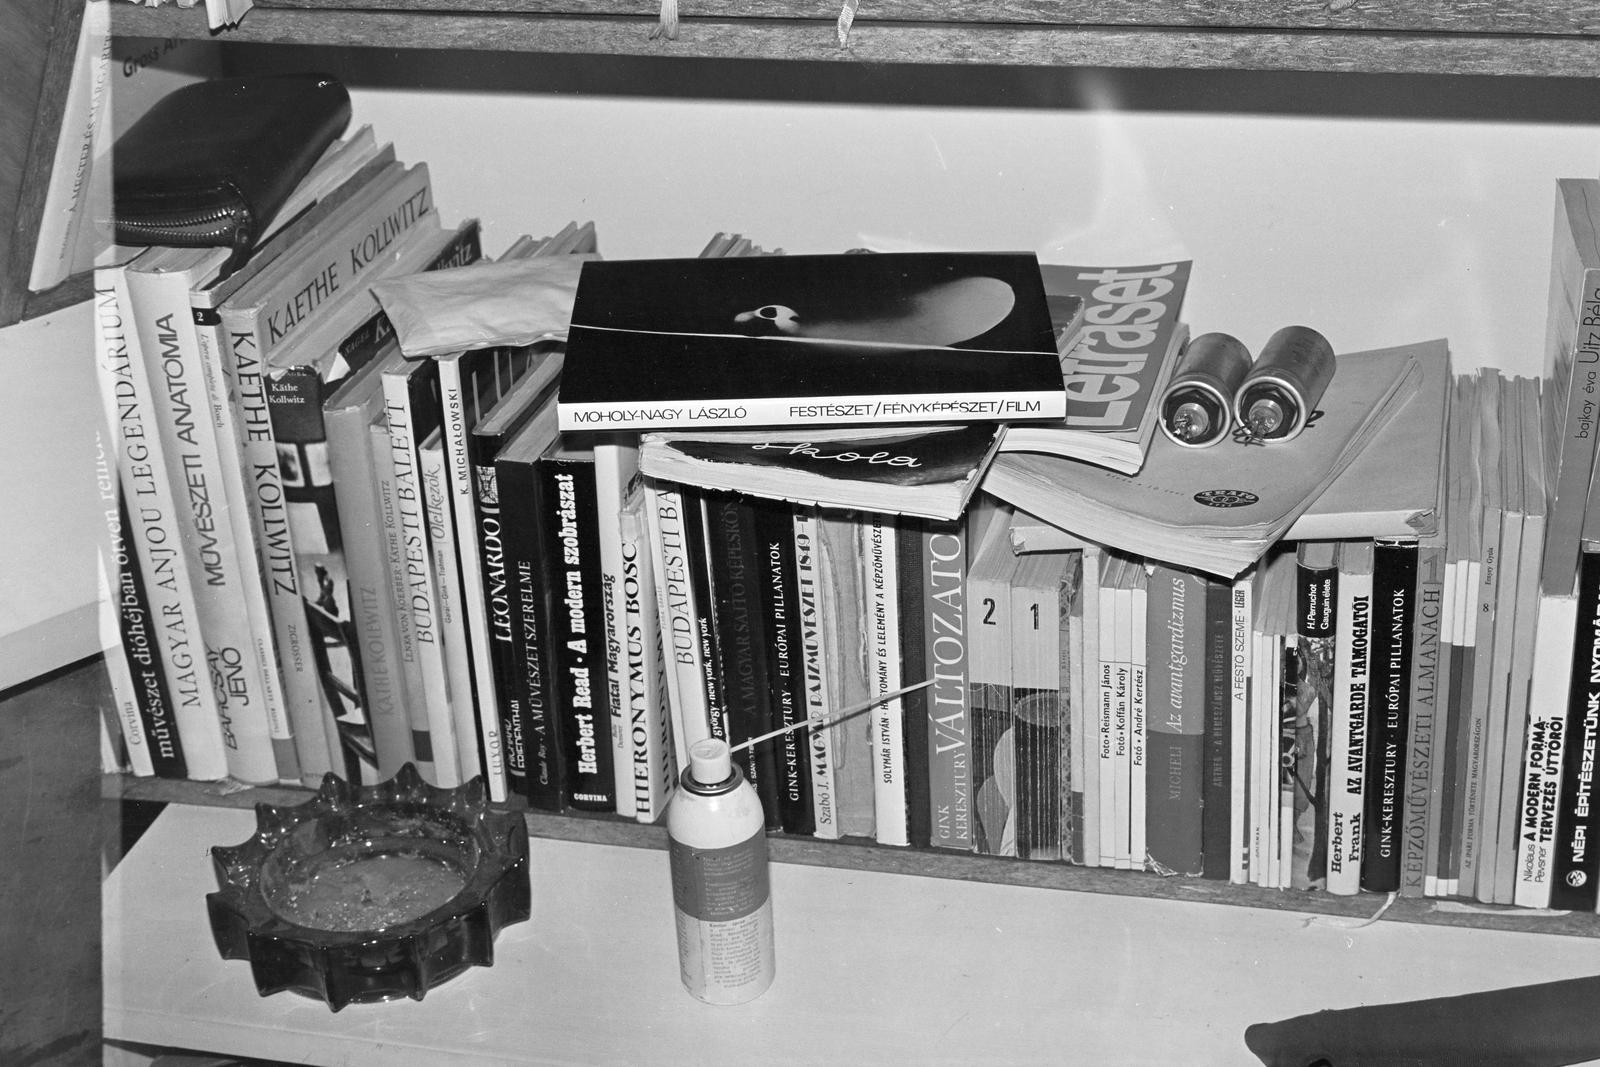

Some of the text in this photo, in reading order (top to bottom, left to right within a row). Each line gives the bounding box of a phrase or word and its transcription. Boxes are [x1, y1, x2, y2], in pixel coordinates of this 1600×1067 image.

[265, 185, 430, 345] KAETHE KOLLWITZ
[196, 311, 204, 322] 2
[1065, 263, 1178, 426] Letraset
[1578, 330, 1600, 365] Uitz
[95, 285, 157, 497] LEGENDÁRIUM
[156, 313, 198, 445] ANATÓMIA
[268, 394, 305, 404] Kollwitz
[271, 383, 299, 392] Käthe
[1583, 371, 1597, 394] éva
[213, 404, 223, 428] Bosch
[574, 406, 747, 423] MOHOLY-NAGY LÁSZLÓ
[1574, 400, 1596, 440] bajkay
[231, 331, 298, 596] KAETHE KOLLWITZ
[448, 388, 471, 495] K. MICHAŁOWSKI
[381, 480, 396, 530] KOLLWITZ
[387, 399, 434, 644] BUDAPESTI BALETT
[656, 489, 679, 521] BA
[103, 510, 129, 566] ötven
[140, 508, 177, 592] ANJOU
[870, 513, 884, 590] KÉPZŐMŰVÉSZET
[481, 518, 513, 643] LEONARDO
[517, 561, 538, 642] SZERELME
[661, 530, 696, 667] BUDAPESTI
[769, 542, 786, 620] PILLANATOK
[875, 592, 884, 600] A
[1320, 579, 1332, 630] Gauguin élete
[121, 571, 152, 665] dióhéjban
[554, 473, 598, 775] Herbert Read A modern szobrászat
[602, 573, 620, 674] Magyarország
[730, 581, 750, 634] SAJTÓ
[874, 601, 887, 643] LELEMÉNY
[982, 597, 997, 626] 2
[1030, 603, 1039, 630] 1
[1234, 615, 1245, 652] SZEME
[163, 603, 201, 707] MAGYAR
[288, 624, 304, 673] ZIGROSSER
[735, 633, 754, 699] MAGYAR
[774, 622, 790, 677] EURÓPAI
[876, 643, 887, 657] ÉS
[928, 533, 967, 756] VÁLTOZATO
[1416, 588, 1441, 706] ALMANACH
[523, 644, 544, 723] MŰVÉSZET
[607, 679, 622, 718] Fiatal
[621, 542, 650, 814] HIERONYMUS BOSC
[699, 617, 724, 736] györgy new york, new york
[1101, 664, 1111, 688] János
[1166, 578, 1188, 801] MICHELI Az avantgardizmus
[1234, 692, 1244, 701] A
[124, 701, 141, 745] Corvina
[141, 670, 175, 758] művészet
[534, 724, 545, 734] A
[744, 704, 754, 716] A
[880, 717, 891, 748] ISTVÁN
[1101, 687, 1111, 735] Reismann
[1116, 667, 1128, 757] Fotó Koffán Károly
[1133, 669, 1144, 767] Fotó André Kertész
[1348, 682, 1366, 774] AVANTGARDE
[1379, 588, 1406, 858] GINK-KERESZTURY EURÓPAI PILLANATOK
[488, 730, 503, 776] LUXOR
[881, 749, 893, 784] SOLYMÁR
[1471, 717, 1482, 779] MAGYARORSZÁGON
[1575, 692, 1600, 818] ÉPÍTÉSZETÜNK
[573, 793, 608, 802] CORVINA
[818, 781, 829, 790] J.
[953, 750, 969, 840] KERESZTURY
[1346, 777, 1362, 795] AZ
[1405, 713, 1433, 888] KÉPZŐMŰVÉSZETI
[1467, 781, 1477, 816] TÖRTÉNETE
[1523, 716, 1547, 842] A MODERN FORMA-
[1539, 716, 1564, 844] TERVEZÉS ÚTTÖRŐI
[817, 791, 832, 825] Szabó
[938, 804, 950, 840] GINK
[1466, 818, 1474, 842] FORMA
[1330, 811, 1344, 875] Herbert
[1348, 812, 1362, 863] Frank
[1523, 843, 1536, 883] Nikolaus
[1571, 825, 1588, 863] NÉPI
[1535, 845, 1547, 884] Pevsner
